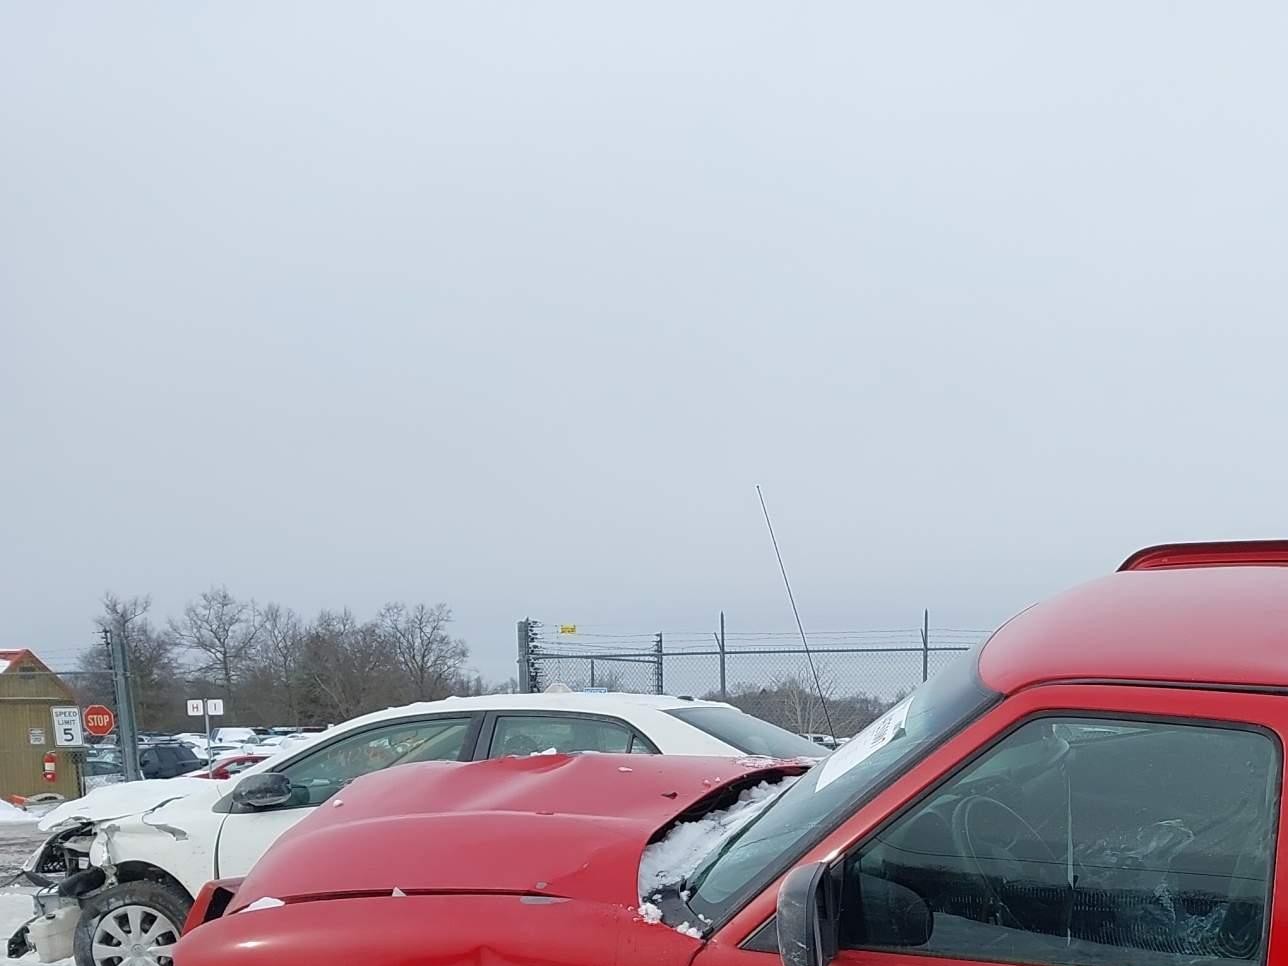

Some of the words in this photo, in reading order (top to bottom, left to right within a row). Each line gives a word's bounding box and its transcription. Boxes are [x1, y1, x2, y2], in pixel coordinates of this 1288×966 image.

[192, 703, 199, 712] H
[87, 715, 110, 726] STOP
[63, 728, 74, 742] 5
